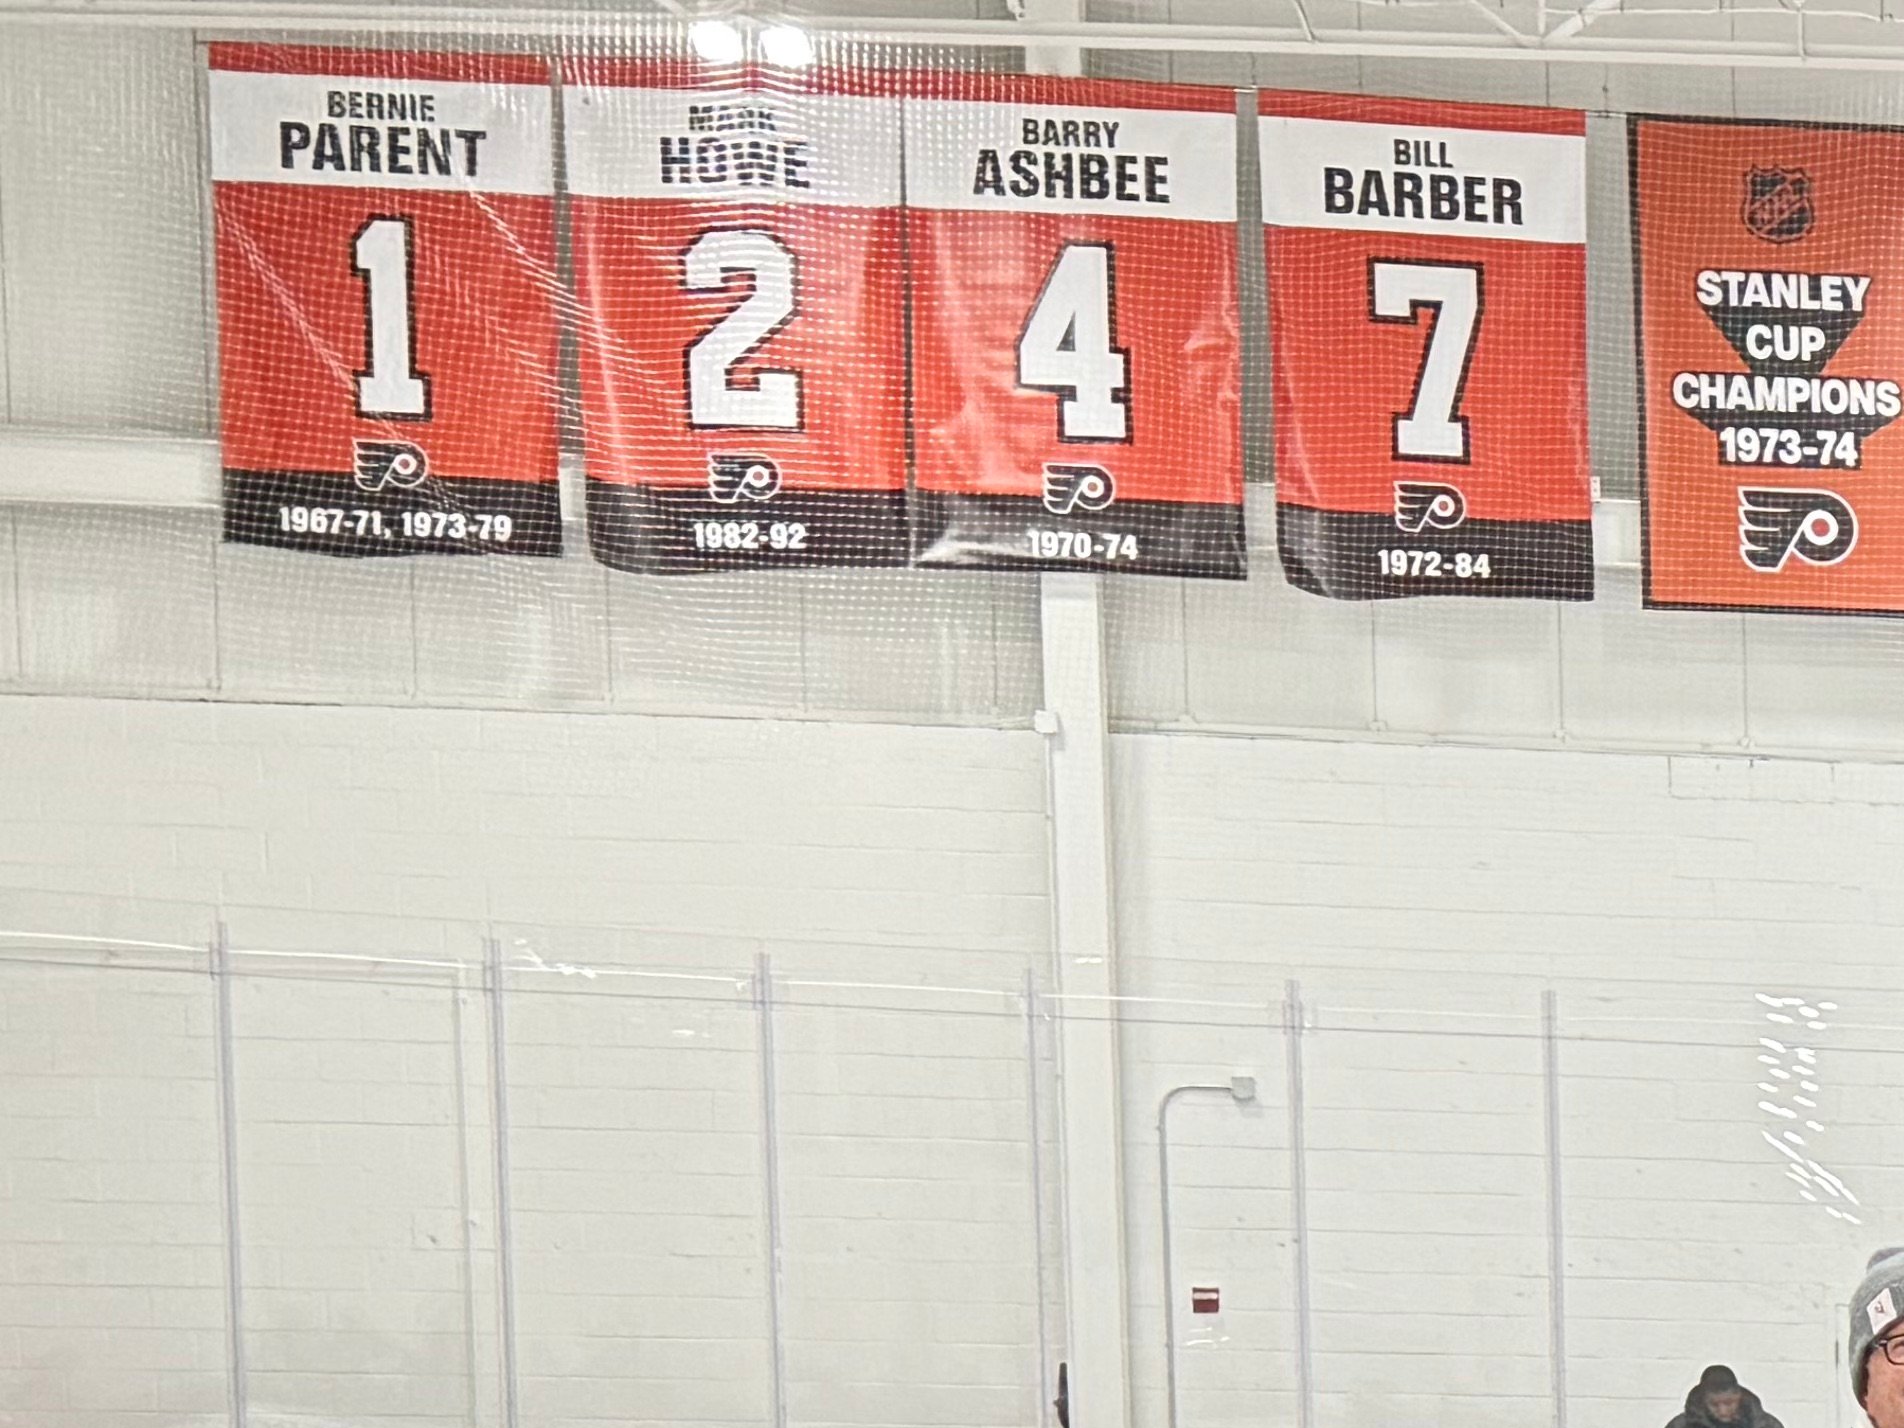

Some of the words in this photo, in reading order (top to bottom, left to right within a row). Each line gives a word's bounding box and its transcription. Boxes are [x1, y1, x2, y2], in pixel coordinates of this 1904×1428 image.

[326, 90, 436, 123] BERNIE
[280, 121, 486, 178] PARENT
[1022, 117, 1120, 148] BARRY
[1393, 138, 1453, 170] BILL
[660, 136, 811, 188] HOWE
[973, 149, 1170, 204] ASHBEE
[1324, 168, 1523, 227] BARBER
[1695, 270, 1871, 314] STANLEY
[350, 213, 433, 420] 1
[678, 226, 806, 432] 2
[1014, 239, 1134, 447] 4
[1367, 256, 1485, 464] 7
[1745, 322, 1826, 363] CUP
[1673, 371, 1902, 420] CHAMPIONS
[1718, 425, 1860, 469] 1973-74
[401, 509, 512, 543] 1973-79
[693, 519, 807, 551] 1982-92
[1027, 529, 1138, 561] 1970-74
[1377, 547, 1492, 580] 1972-84
